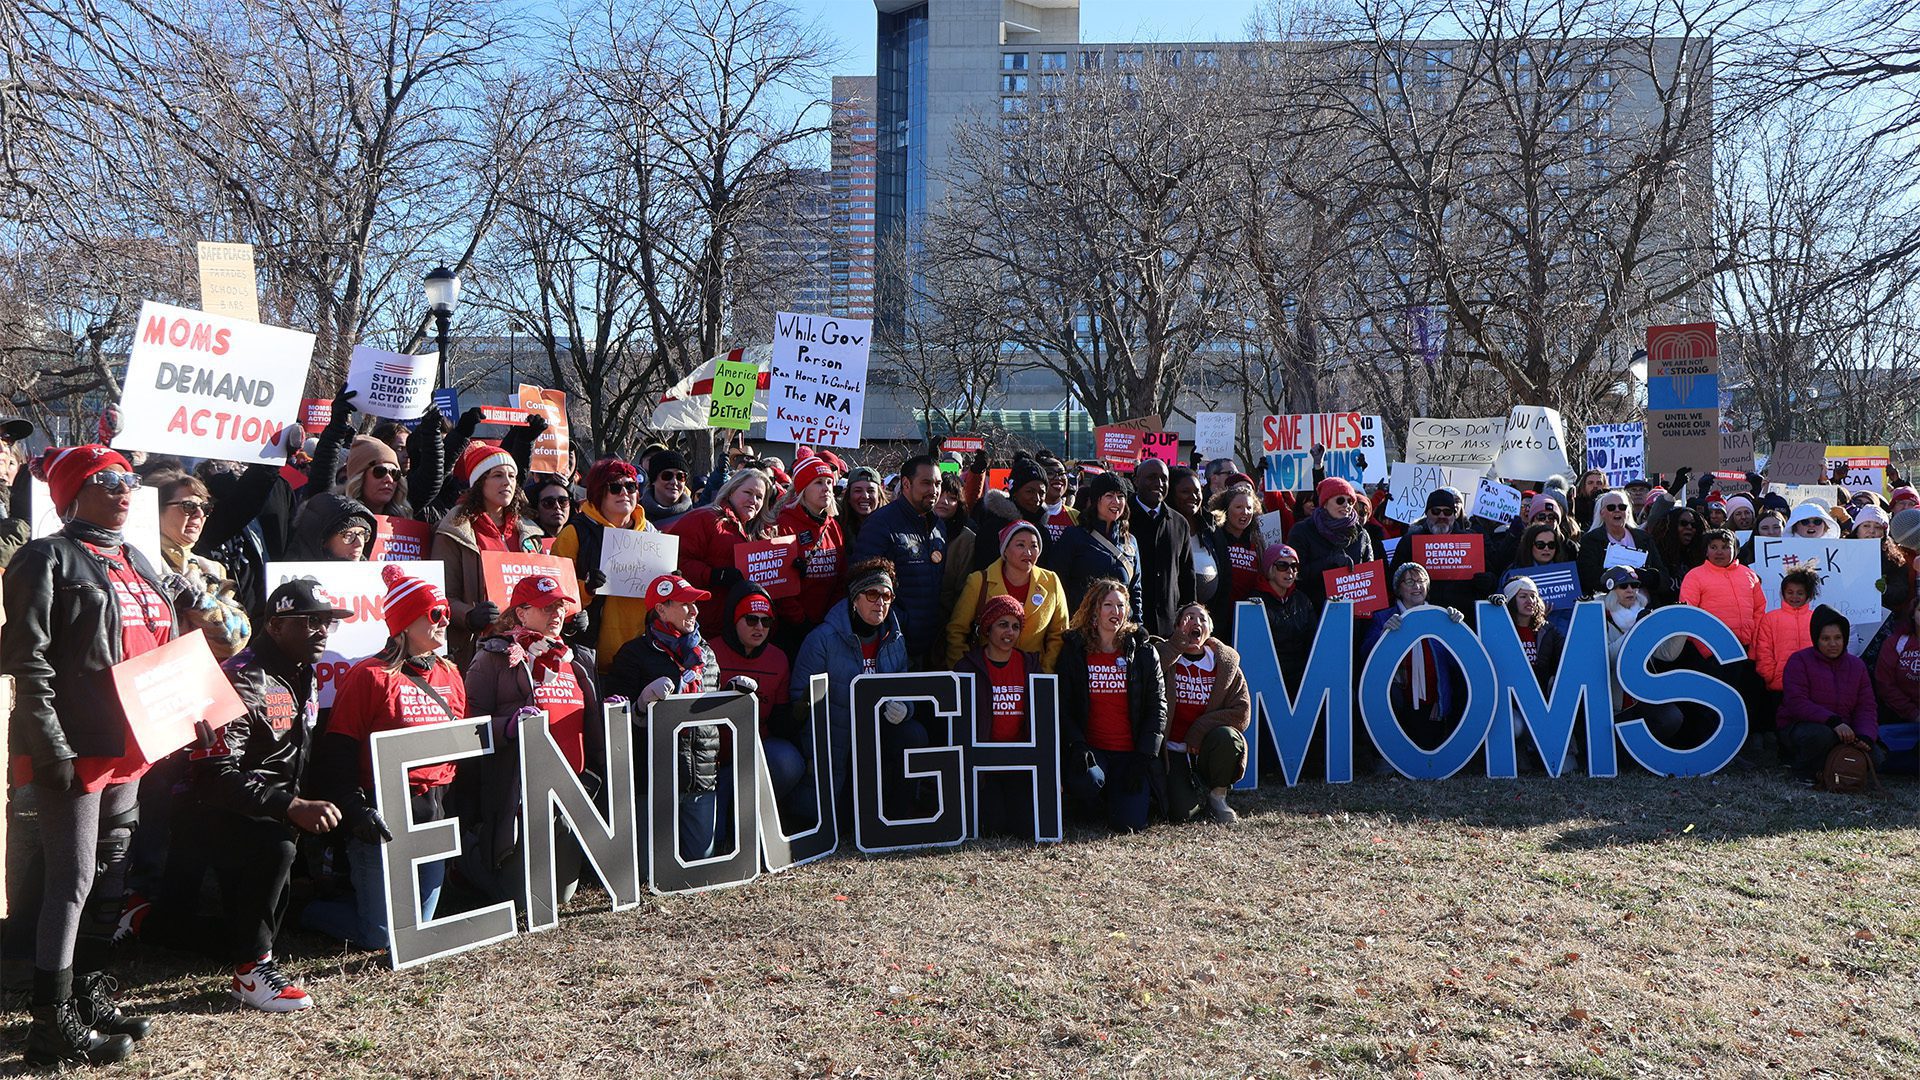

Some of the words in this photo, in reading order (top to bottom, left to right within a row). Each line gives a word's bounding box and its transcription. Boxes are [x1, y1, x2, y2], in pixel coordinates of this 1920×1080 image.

[200, 247, 222, 260] SAFE
[224, 247, 252, 262] PLACES
[209, 284, 249, 297] SCHOOLS
[143, 315, 231, 355] MOMS
[777, 313, 817, 343] While
[821, 320, 864, 347] Gov.
[797, 345, 842, 370] Parson
[715, 363, 757, 381] America
[155, 362, 275, 407] DEMAND
[372, 373, 427, 386] STUDENTS
[771, 366, 790, 379] Ran
[795, 369, 817, 384] Home
[830, 377, 861, 394] Comfort
[370, 383, 418, 396] DEMAND
[723, 381, 745, 397] DO
[369, 393, 413, 404] ACTION
[784, 385, 807, 403] The
[814, 391, 851, 415] NRA
[709, 400, 752, 421] BETTER!
[1665, 413, 1688, 421] UNTIL
[1689, 412, 1703, 420] WE
[167, 405, 283, 446] ACTION
[776, 406, 819, 426] Kansas
[824, 415, 851, 436] City
[1588, 426, 1601, 434] TO
[1601, 424, 1621, 433] THE
[1622, 422, 1643, 433] GUN
[1657, 421, 1691, 429] CHANGE
[1693, 420, 1711, 428] OUR
[789, 425, 839, 446] WEPT
[1263, 414, 1303, 452] SAVE
[1310, 412, 1362, 450] LIVES
[1412, 421, 1461, 438] COPS
[1466, 421, 1504, 435] DON'T
[1662, 429, 1681, 437] GUN
[1682, 428, 1706, 436] LAWS
[1104, 437, 1133, 445] DEMAND
[1159, 433, 1178, 446] UP
[1415, 440, 1454, 450] STOP
[1460, 439, 1490, 449] MASS
[1525, 436, 1543, 450] to
[1588, 434, 1642, 448] INDUSTRY
[1723, 434, 1750, 450] NRA
[1415, 452, 1494, 463] SHOOTINGS
[1779, 443, 1819, 460] FUCK
[1588, 449, 1608, 470] NO
[1611, 448, 1641, 470] Lives
[1265, 453, 1308, 491] NOT
[1413, 465, 1452, 487] BAN
[1777, 461, 1815, 477] YOUR
[1607, 469, 1638, 486] TTER
[1480, 480, 1499, 496] Pass
[1479, 494, 1497, 507] Gun
[1497, 497, 1518, 513] Sense
[1479, 507, 1499, 520] Laws
[384, 541, 421, 555] ACTION
[612, 532, 633, 552] NO
[634, 535, 663, 558] MORE
[1425, 542, 1455, 550] MOMS
[747, 550, 774, 562] MOMS
[1230, 552, 1255, 562] MAND
[1425, 549, 1467, 558] DEMAND
[1425, 556, 1462, 565] ACTION
[748, 559, 783, 573] DEMAND
[1231, 558, 1252, 567] TION
[501, 564, 541, 576] MOMS
[748, 569, 779, 583] ACTION
[1335, 573, 1361, 586] MOMS
[1336, 580, 1371, 593] DEMAND
[1343, 588, 1369, 600] CTION
[1539, 582, 1575, 597] RYTOWN
[992, 685, 1008, 694] MS
[1235, 598, 1750, 790] MOMS
[265, 693, 292, 704] SUPER
[992, 692, 1021, 703] MAND
[266, 704, 294, 718] BOWL
[992, 702, 1016, 711] TION
[369, 671, 1064, 971] ENOUGH
